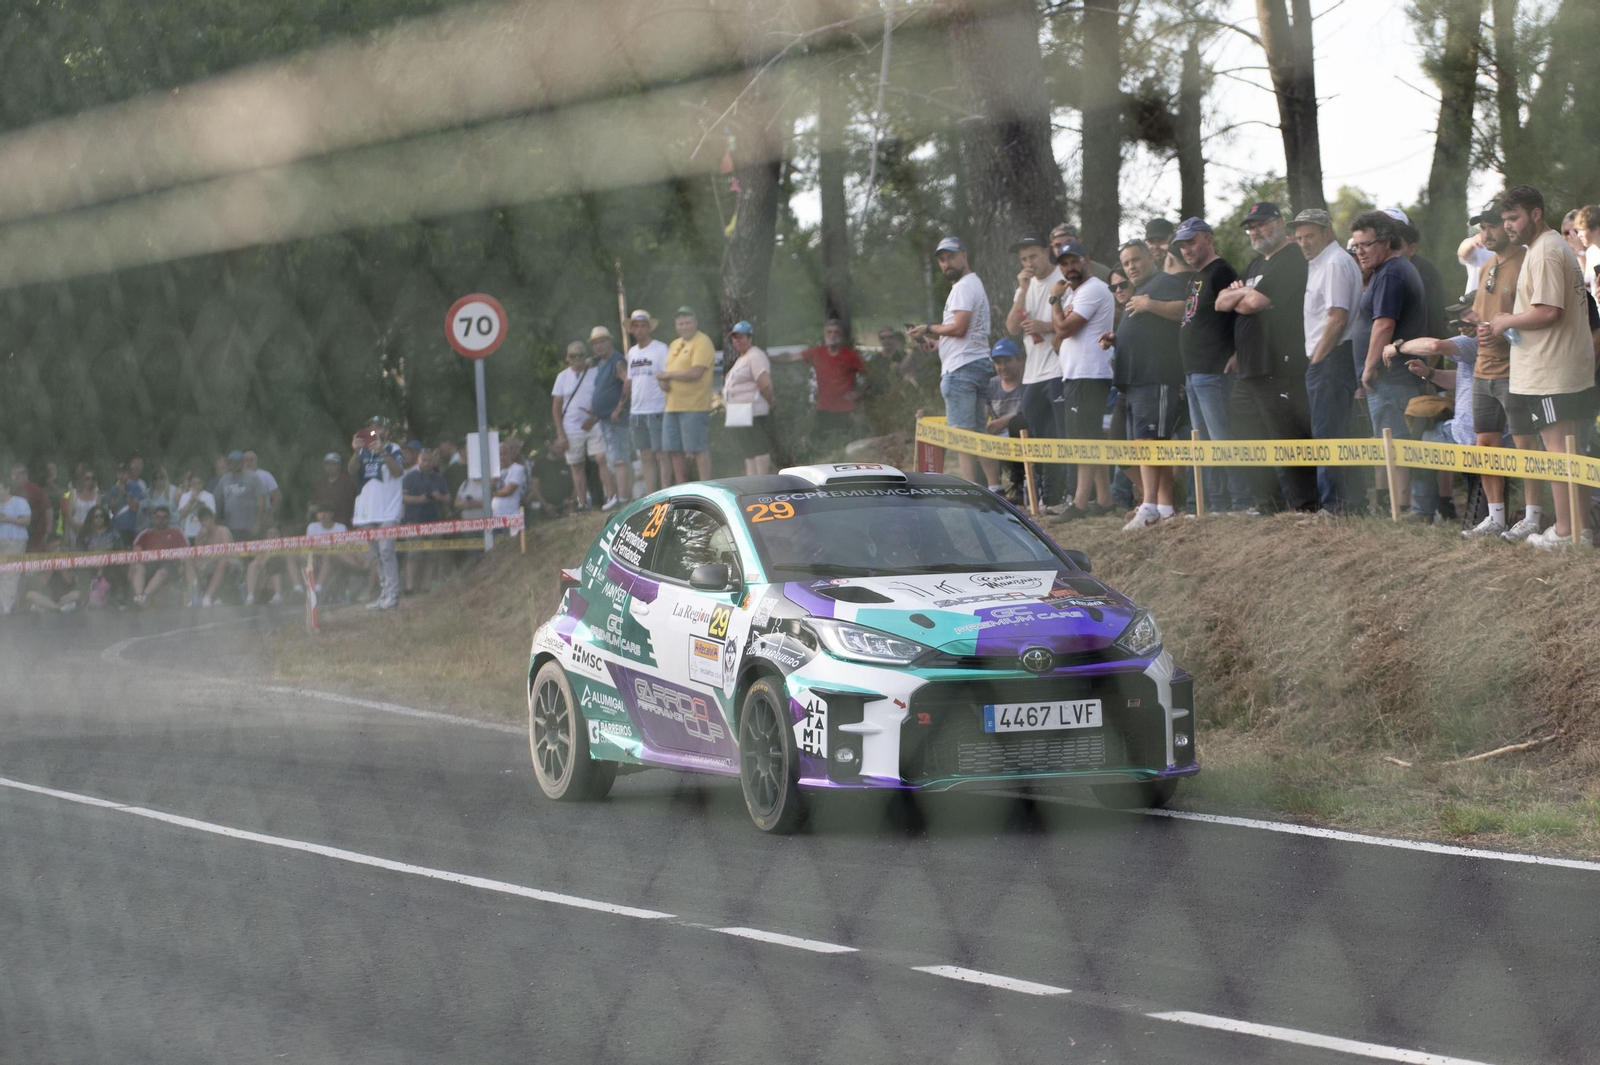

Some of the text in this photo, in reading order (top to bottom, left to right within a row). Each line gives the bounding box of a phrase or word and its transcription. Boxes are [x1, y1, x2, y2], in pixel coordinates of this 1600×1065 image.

[459, 315, 493, 337] 70
[1057, 444, 1073, 459] ZONA
[1074, 444, 1101, 460] PUBLICO
[1105, 445, 1122, 460] ZONA
[1123, 446, 1150, 461] PUBLICO
[1156, 446, 1174, 461] ZONA
[1175, 446, 1204, 462] PUBLCO
[1211, 446, 1232, 461] ZONA
[1234, 446, 1267, 462] PUBLICO
[1274, 446, 1295, 461] ZONA
[1297, 446, 1330, 462] PUBLICO
[1338, 445, 1360, 461] ZONA
[1403, 446, 1423, 462] ZONA
[1425, 448, 1455, 467] PUBLICO
[1462, 451, 1482, 468] ZONA
[1485, 453, 1517, 472] PUBLICO
[1524, 456, 1546, 474] ZONA
[1548, 459, 1580, 478] PUBLCO
[774, 488, 968, 502] GCPREMIUMCARS.ES
[642, 503, 670, 538] 29
[746, 502, 795, 523] 29
[400, 526, 418, 537] ZONA
[420, 522, 454, 536] PROHIBIDO
[456, 518, 484, 532] PUBLICO
[487, 516, 504, 529] ZONA
[672, 602, 710, 625] La Región
[709, 607, 731, 637] 29
[954, 610, 1084, 635] PREMIUM CARS
[990, 606, 1034, 618] GC
[606, 613, 623, 636] GC
[581, 650, 603, 672] MSC
[592, 691, 625, 713] ALUMIGAL
[805, 699, 825, 715] AL
[805, 714, 825, 730] TA
[999, 706, 1051, 728] 4467
[1059, 703, 1096, 726] LVF
[600, 722, 632, 737] BARREIROS
[803, 728, 821, 745] MI
